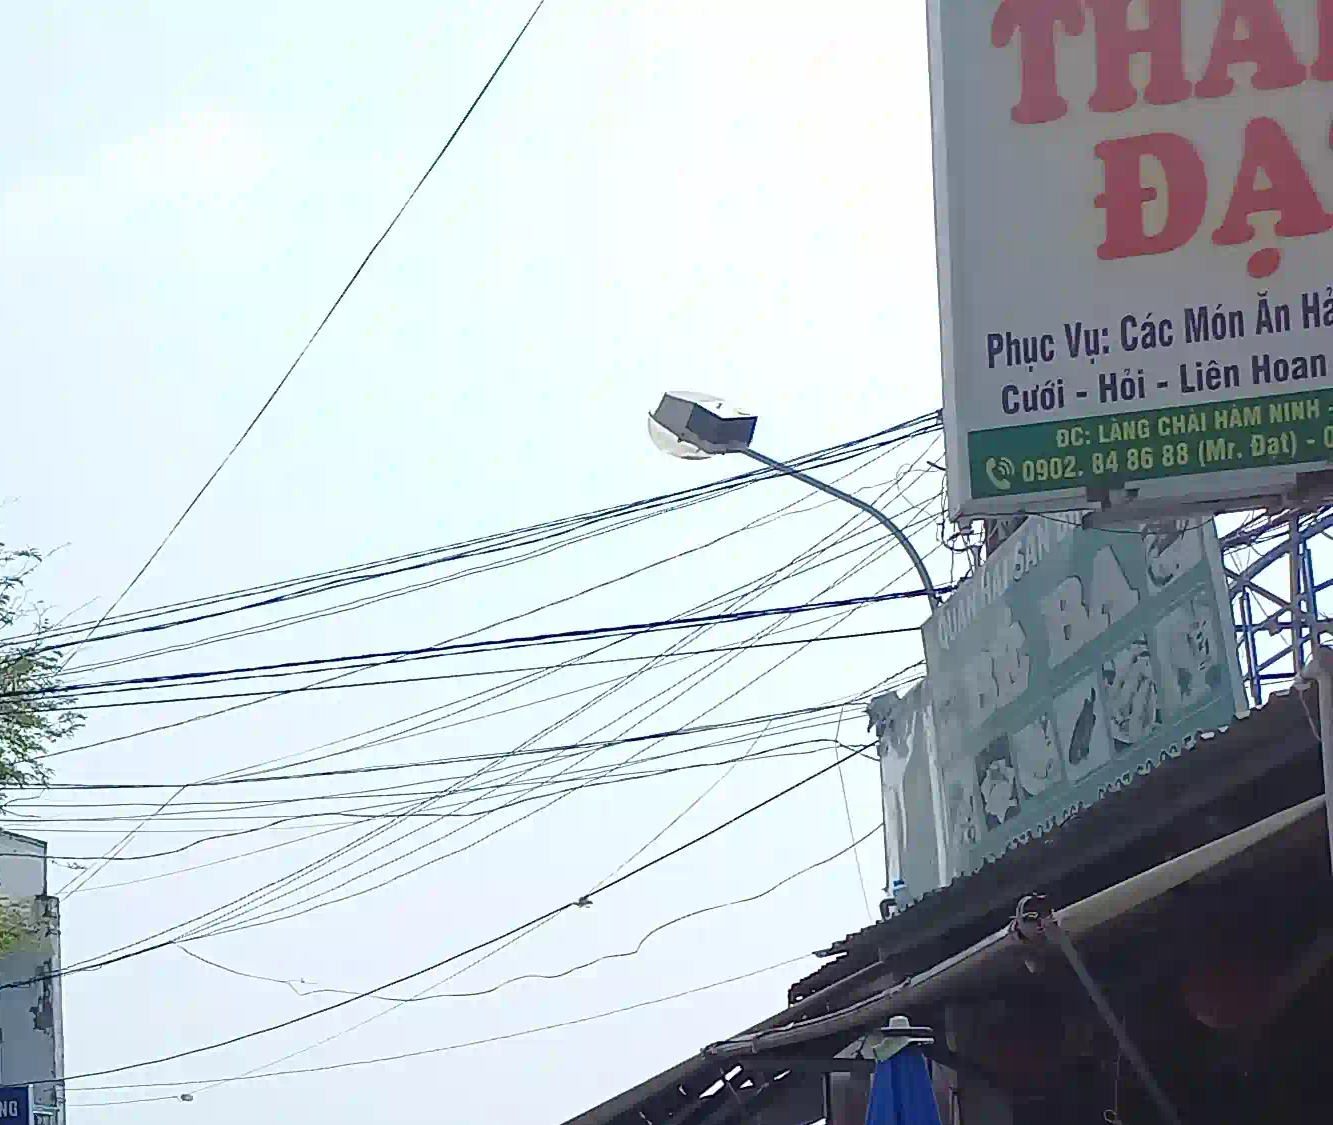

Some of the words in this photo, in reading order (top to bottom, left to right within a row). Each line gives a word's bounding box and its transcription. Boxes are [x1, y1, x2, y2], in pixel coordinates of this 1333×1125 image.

[991, 0, 1333, 124] THA
[1093, 116, 1333, 278] ĐẠ
[987, 332, 1055, 372] Phục
[1063, 321, 1110, 364] Vụ:
[1120, 312, 1174, 351] Các
[1183, 303, 1245, 343] Món
[1255, 289, 1291, 335] Ăn
[1001, 377, 1065, 414] Cưới
[1098, 368, 1146, 403] Hỏi
[1179, 359, 1240, 393] Liên
[1251, 353, 1327, 384] Hoan
[1055, 426, 1091, 448] ĐC:
[1269, 398, 1320, 424] NINH
[1091, 451, 1119, 475] 84
[1126, 447, 1154, 471] 86
[1161, 442, 1189, 467] 88
[1198, 437, 1243, 465] (Mr.
[1250, 431, 1298, 460] Đạt)
